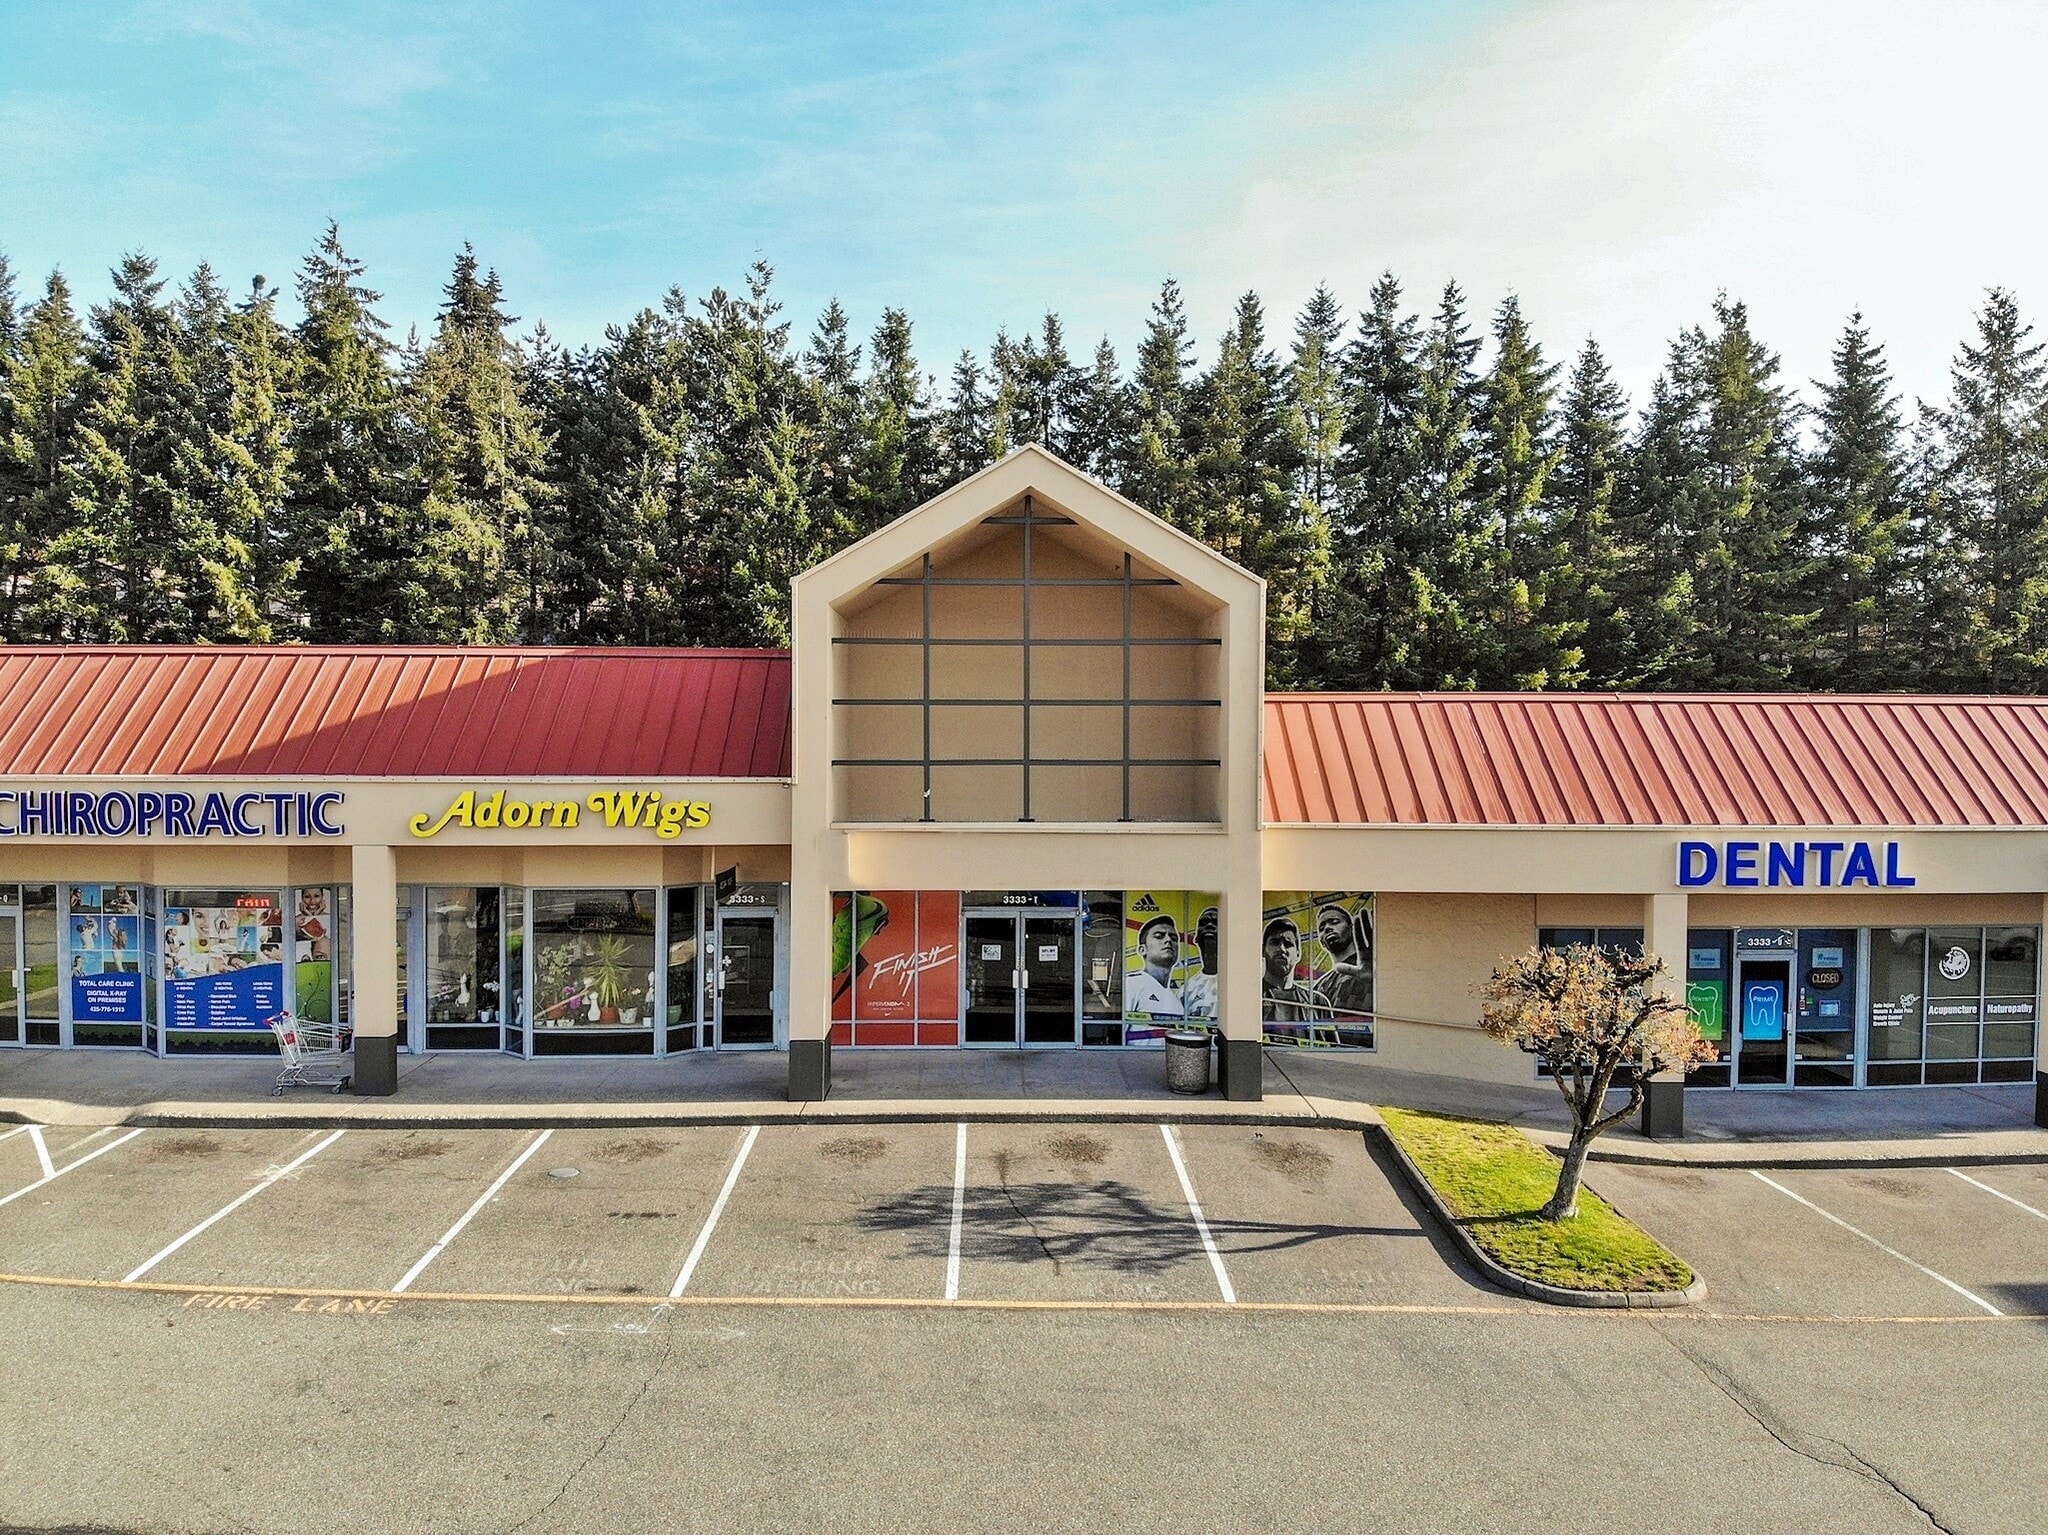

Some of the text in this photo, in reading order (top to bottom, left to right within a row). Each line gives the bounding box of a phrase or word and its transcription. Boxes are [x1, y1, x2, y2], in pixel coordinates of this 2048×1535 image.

[409, 790, 711, 838] Adorn Wigs
[1677, 841, 1917, 887] DENTAL
[869, 945, 954, 989] FINISH
[1812, 973, 1839, 983] CLOSED
[1928, 1005, 1978, 1016] Acupuncture
[1987, 1004, 2034, 1014] Naturopathy
[182, 1294, 399, 1315] FIRE LANE
